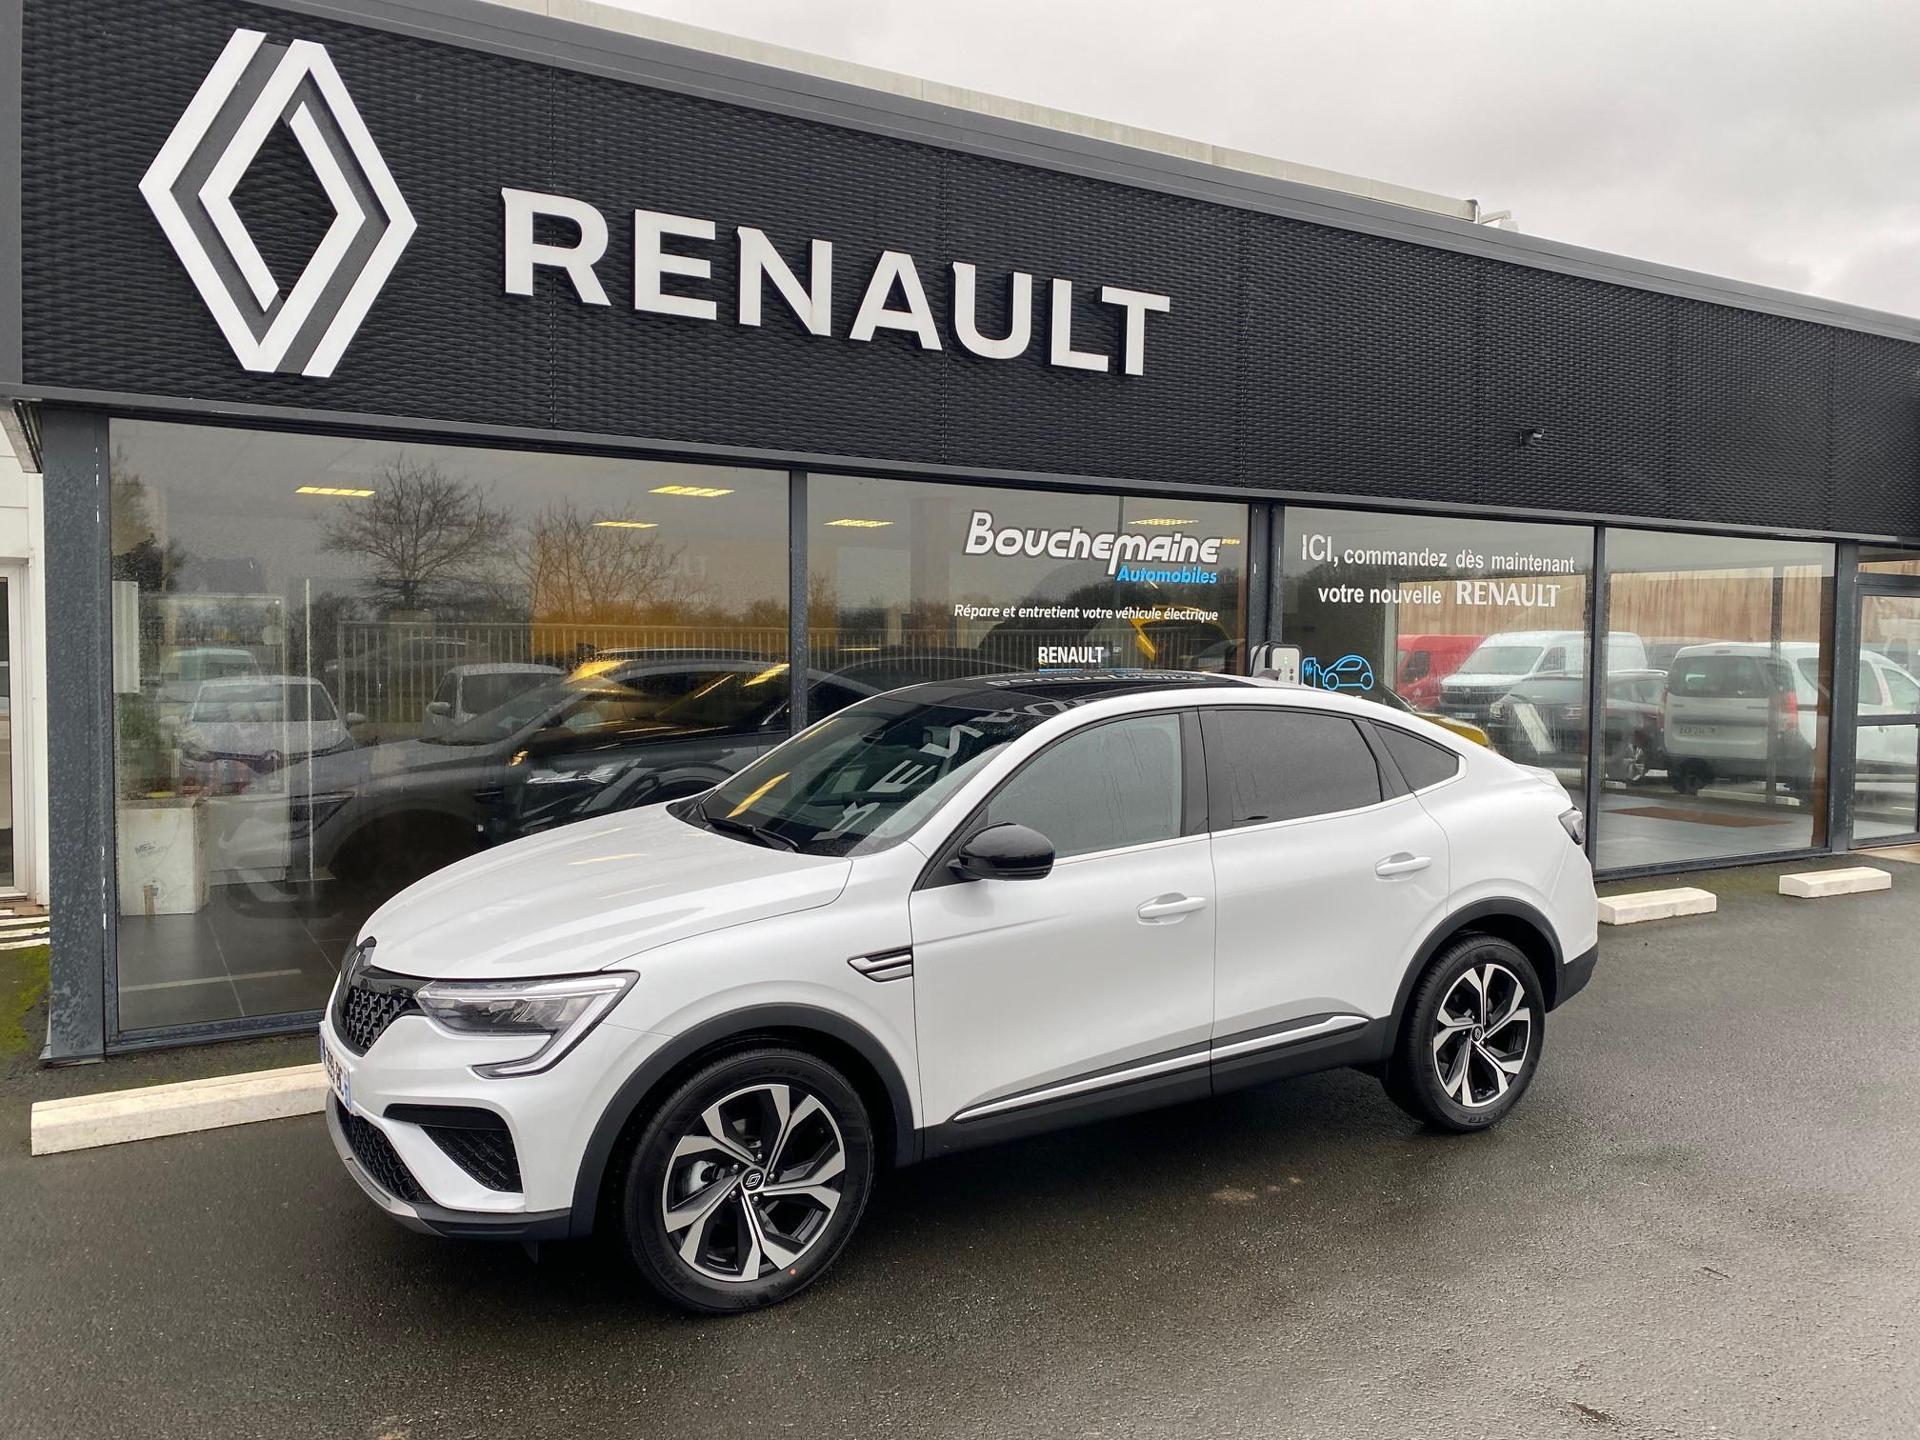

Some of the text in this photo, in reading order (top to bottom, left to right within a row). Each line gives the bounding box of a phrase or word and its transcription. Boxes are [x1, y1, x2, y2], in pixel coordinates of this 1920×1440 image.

[502, 187, 1171, 376] RENAULT
[1302, 534, 1575, 573] ICI, commandez dès maintenant
[1116, 565, 1217, 585] Automobiles
[1317, 580, 1561, 608] votre nouvelle RENAULT
[954, 604, 1218, 624] Répare et entretient votre véhicule électrique
[1038, 646, 1104, 664] RENAULT
